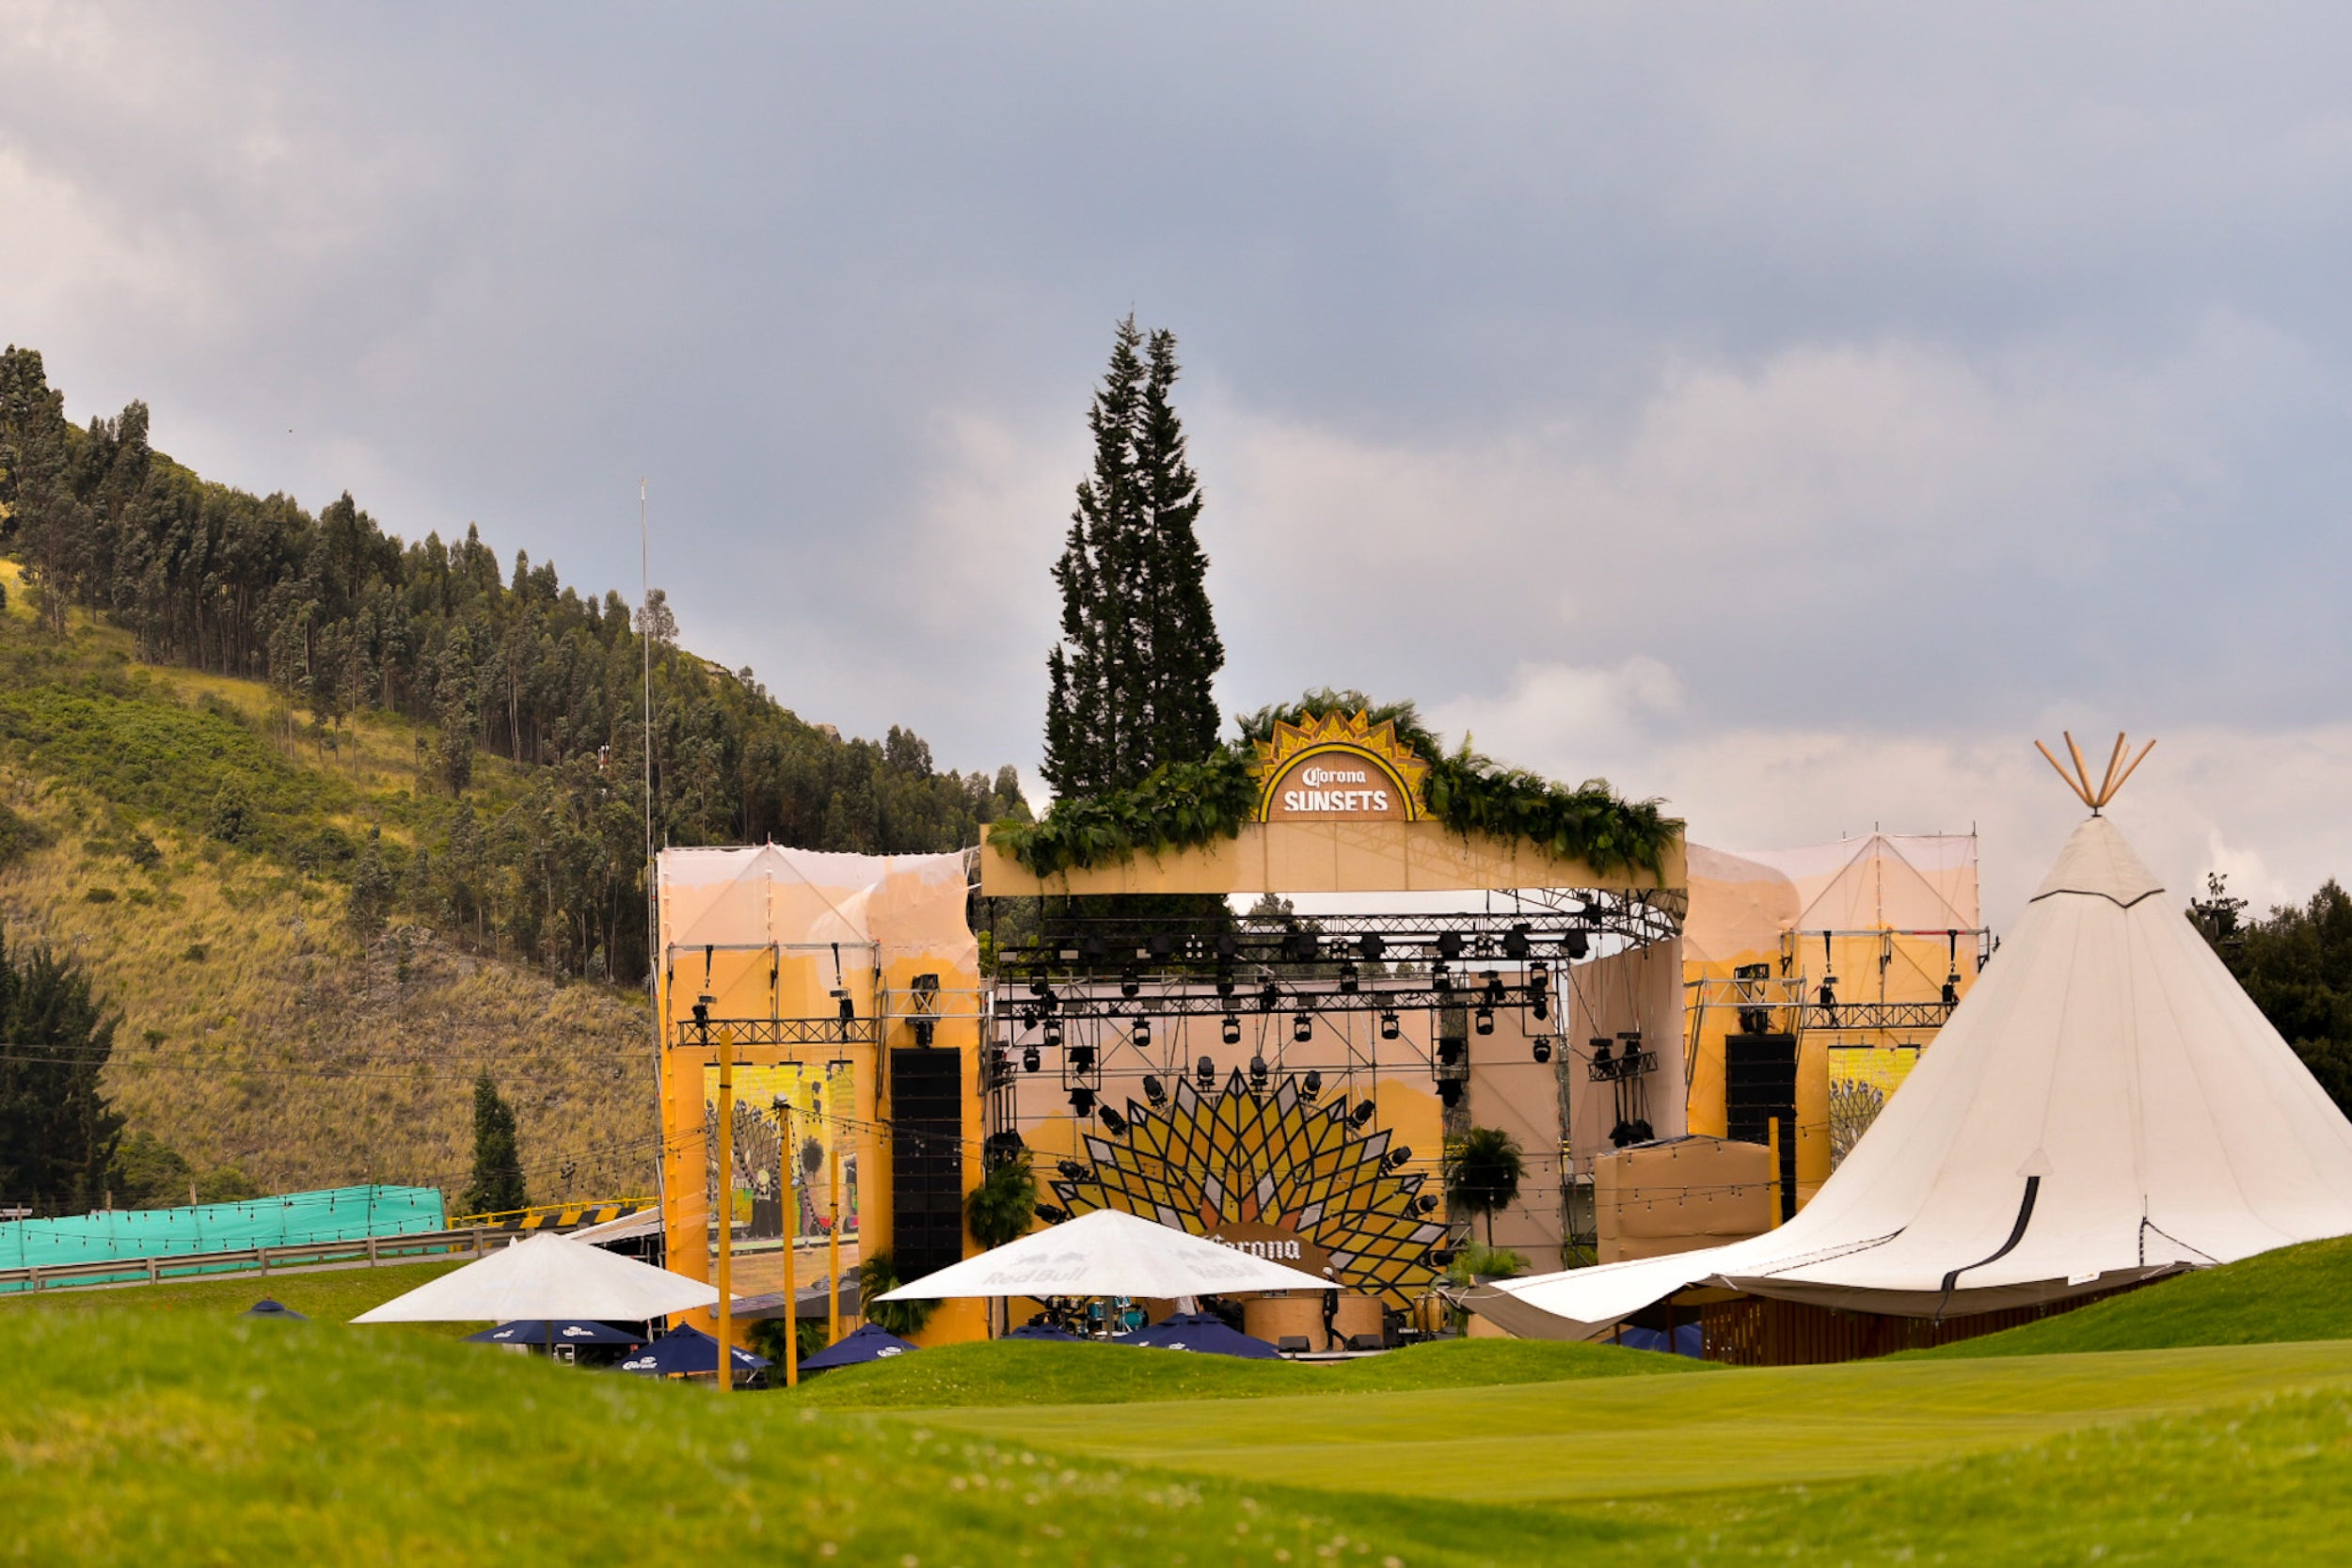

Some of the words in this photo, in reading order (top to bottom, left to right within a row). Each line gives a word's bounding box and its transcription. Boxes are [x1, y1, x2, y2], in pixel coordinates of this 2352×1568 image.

[1302, 767, 1366, 788] Corona
[1284, 790, 1389, 811] SUNSETS
[1204, 1233, 1301, 1259] rona
